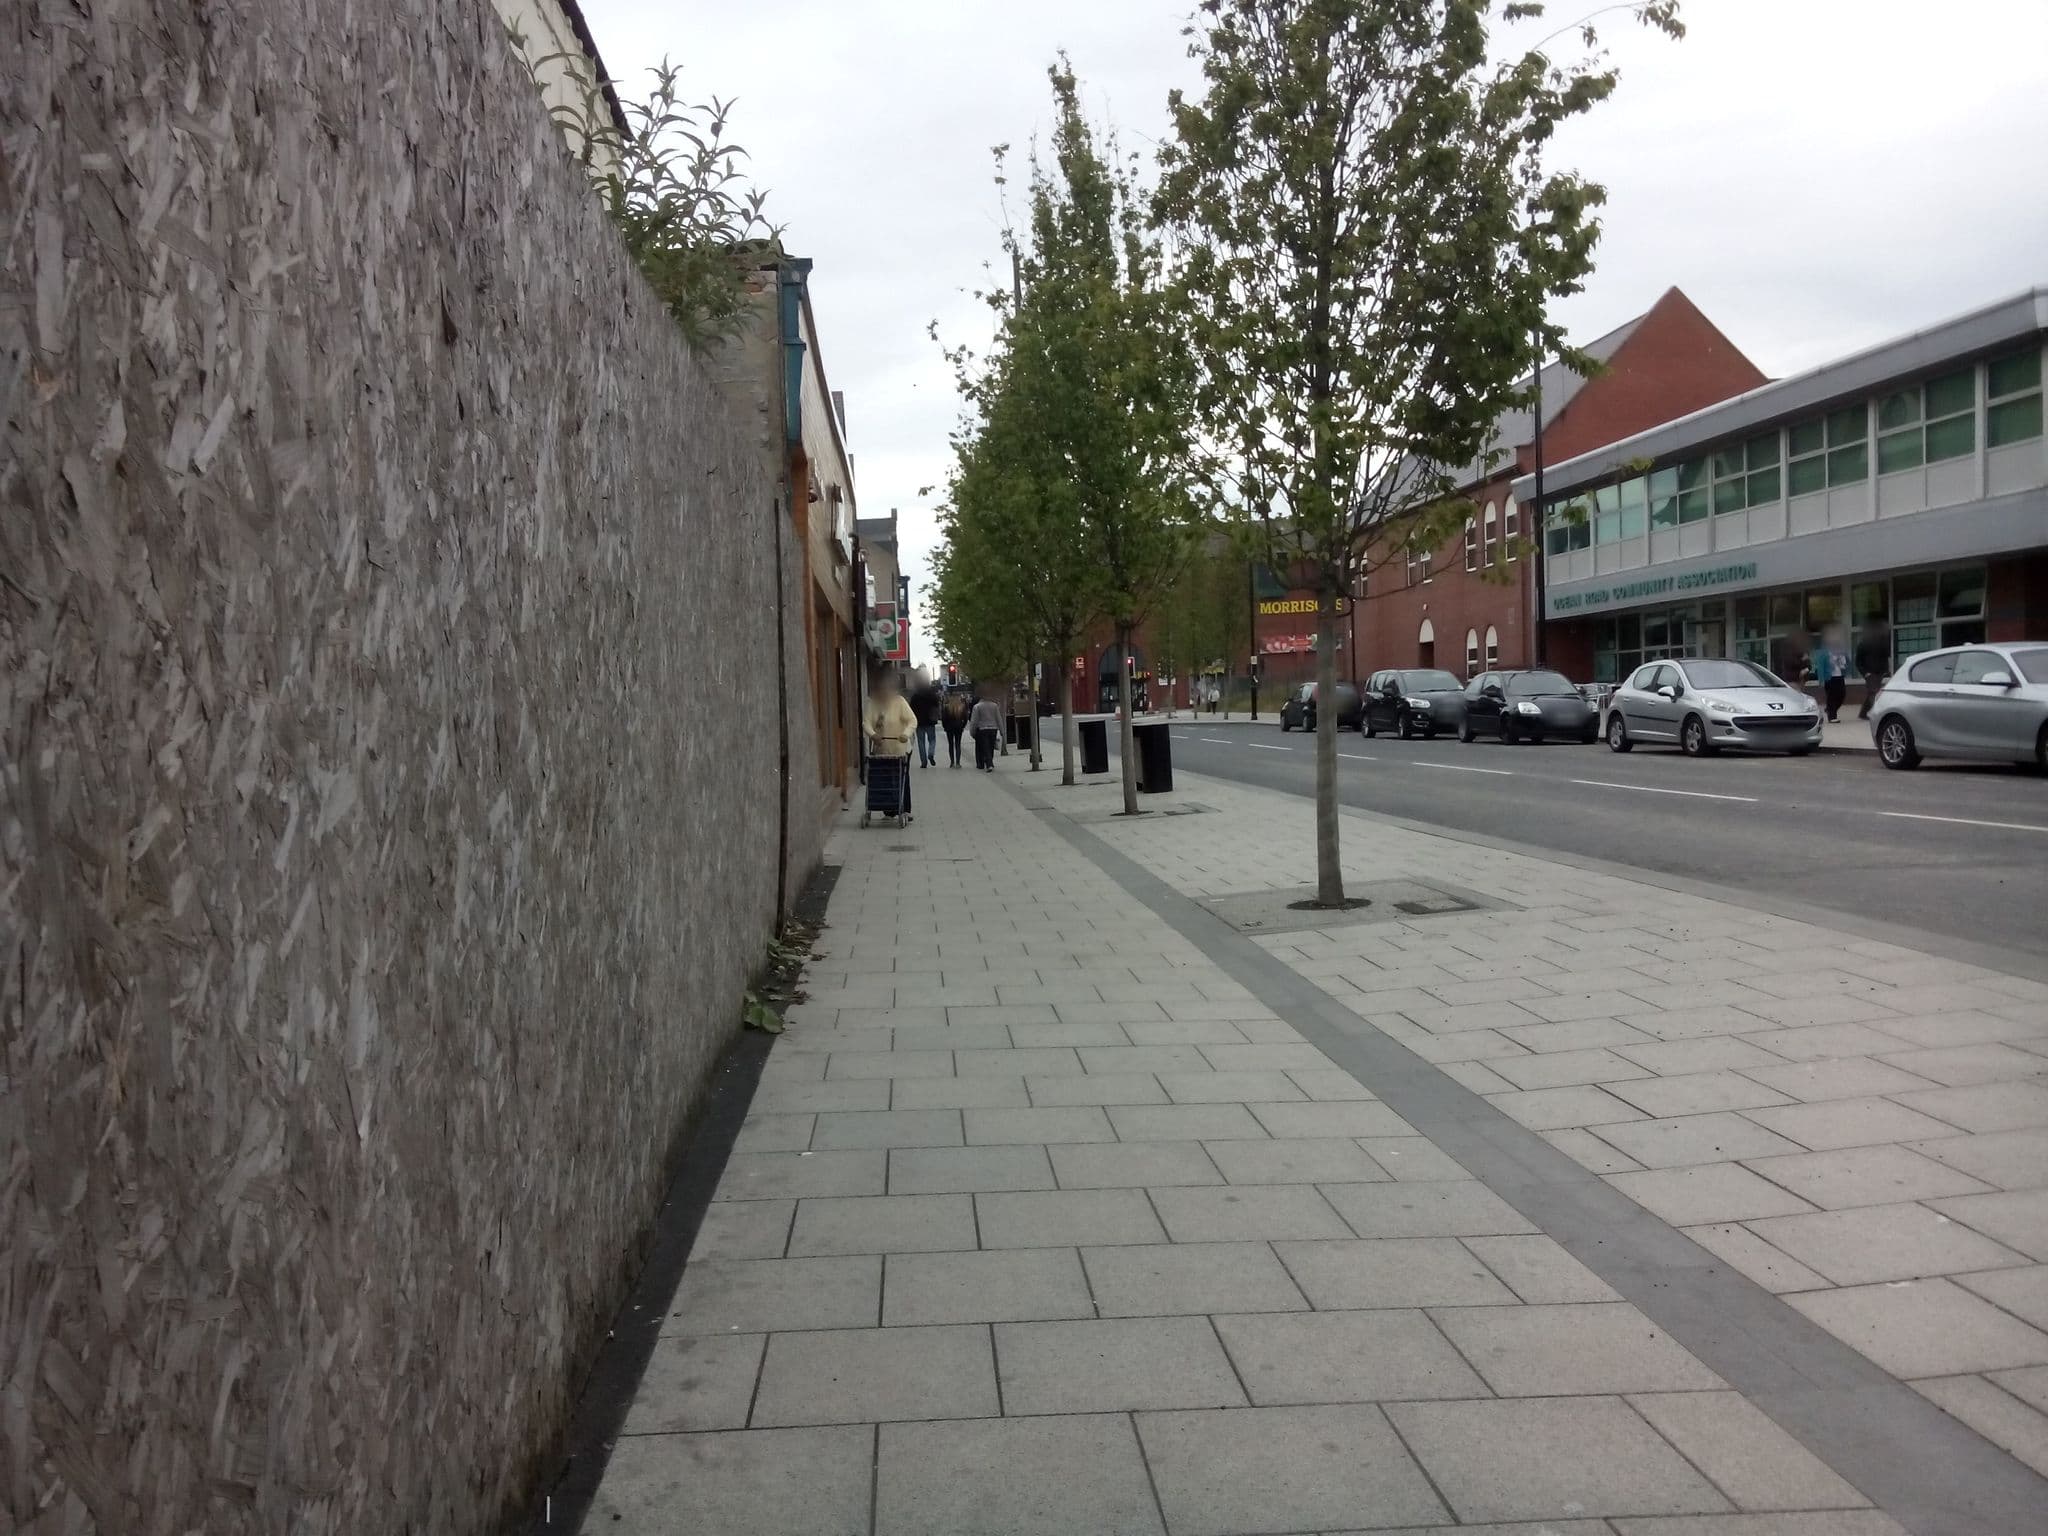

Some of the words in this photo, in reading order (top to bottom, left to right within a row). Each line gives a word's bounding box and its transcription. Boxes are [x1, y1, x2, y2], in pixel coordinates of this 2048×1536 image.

[1612, 576, 1674, 600] COMMUNITY
[1677, 562, 1758, 589] ASSOCIATION
[1260, 598, 1342, 614] MORRISS
